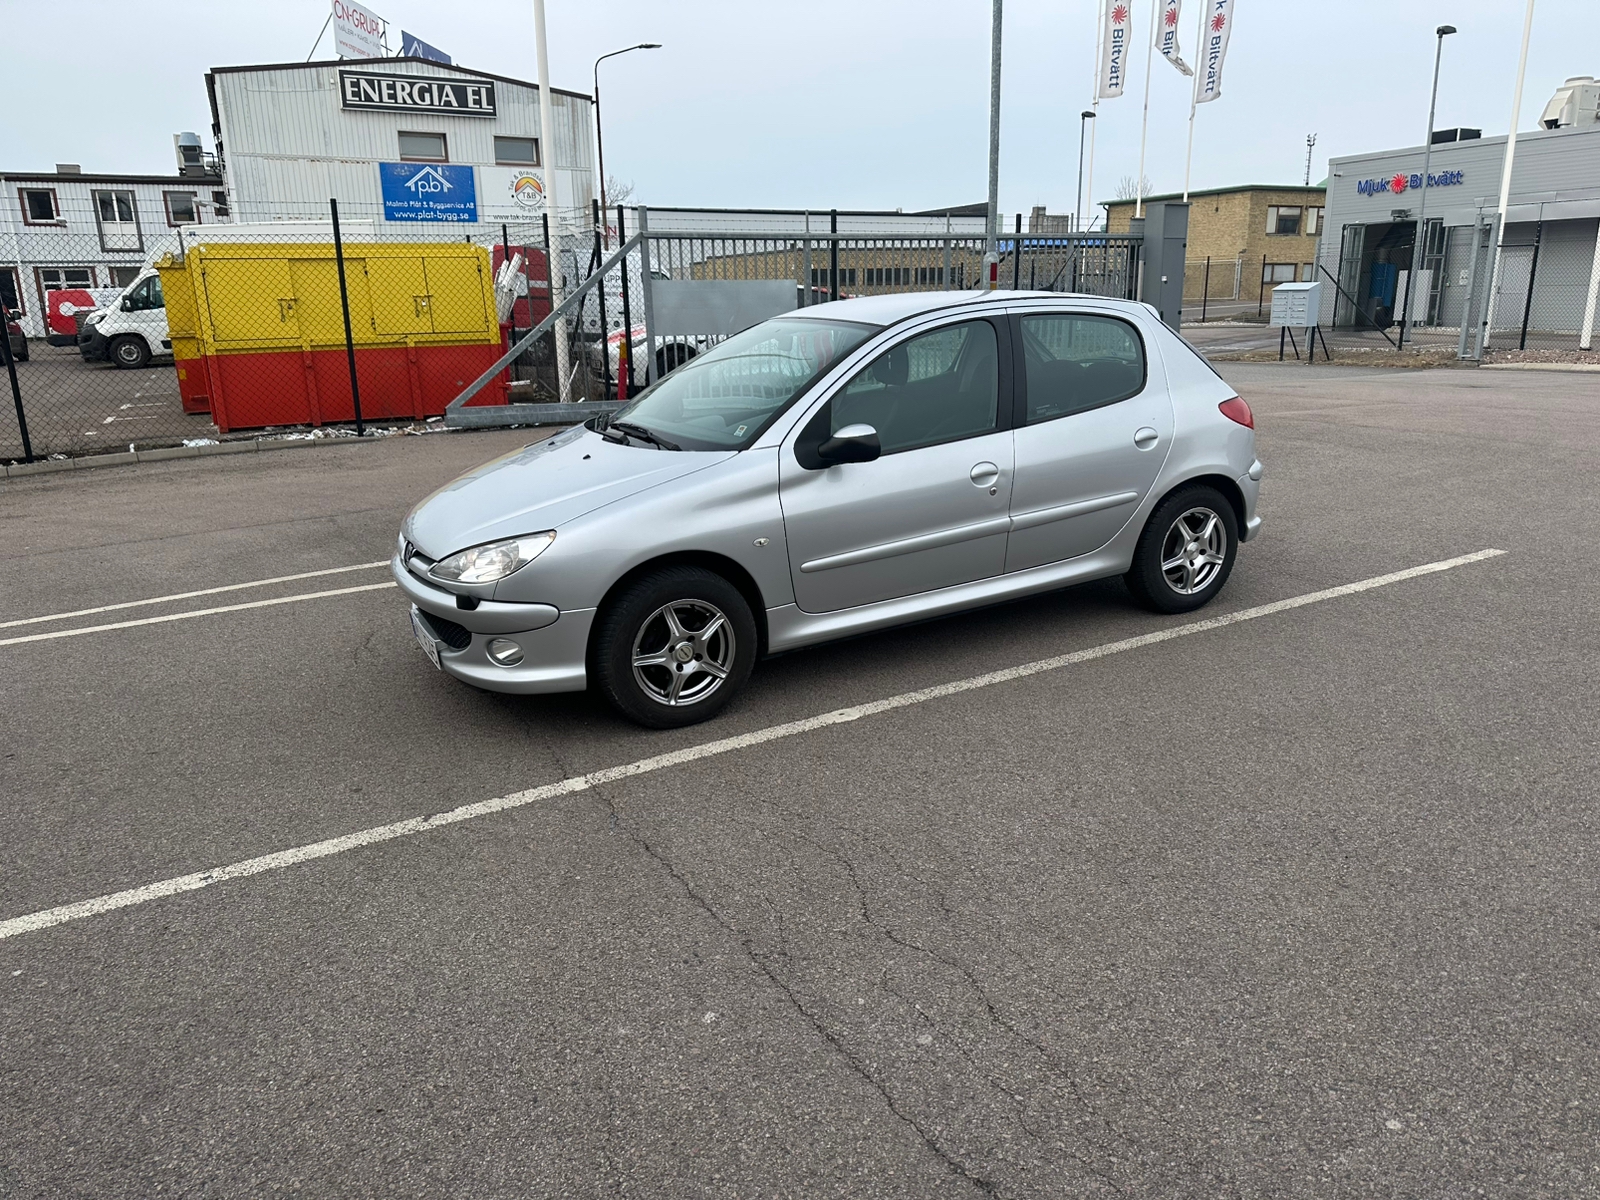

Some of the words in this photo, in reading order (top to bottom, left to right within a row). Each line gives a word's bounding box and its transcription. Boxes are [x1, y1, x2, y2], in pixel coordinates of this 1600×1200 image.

[1109, 28, 1124, 88] Biltvätt
[1205, 35, 1221, 93] Biltvätt
[344, 77, 459, 107] ENERGIA
[466, 86, 494, 109] EL
[508, 180, 516, 191] Tak
[1357, 178, 1389, 197] Mjuk
[1409, 169, 1463, 189] Bitvätt
[522, 191, 537, 199] T&B
[394, 210, 469, 220] www.plat-bygg.se
[429, 202, 464, 210] Byggservice
